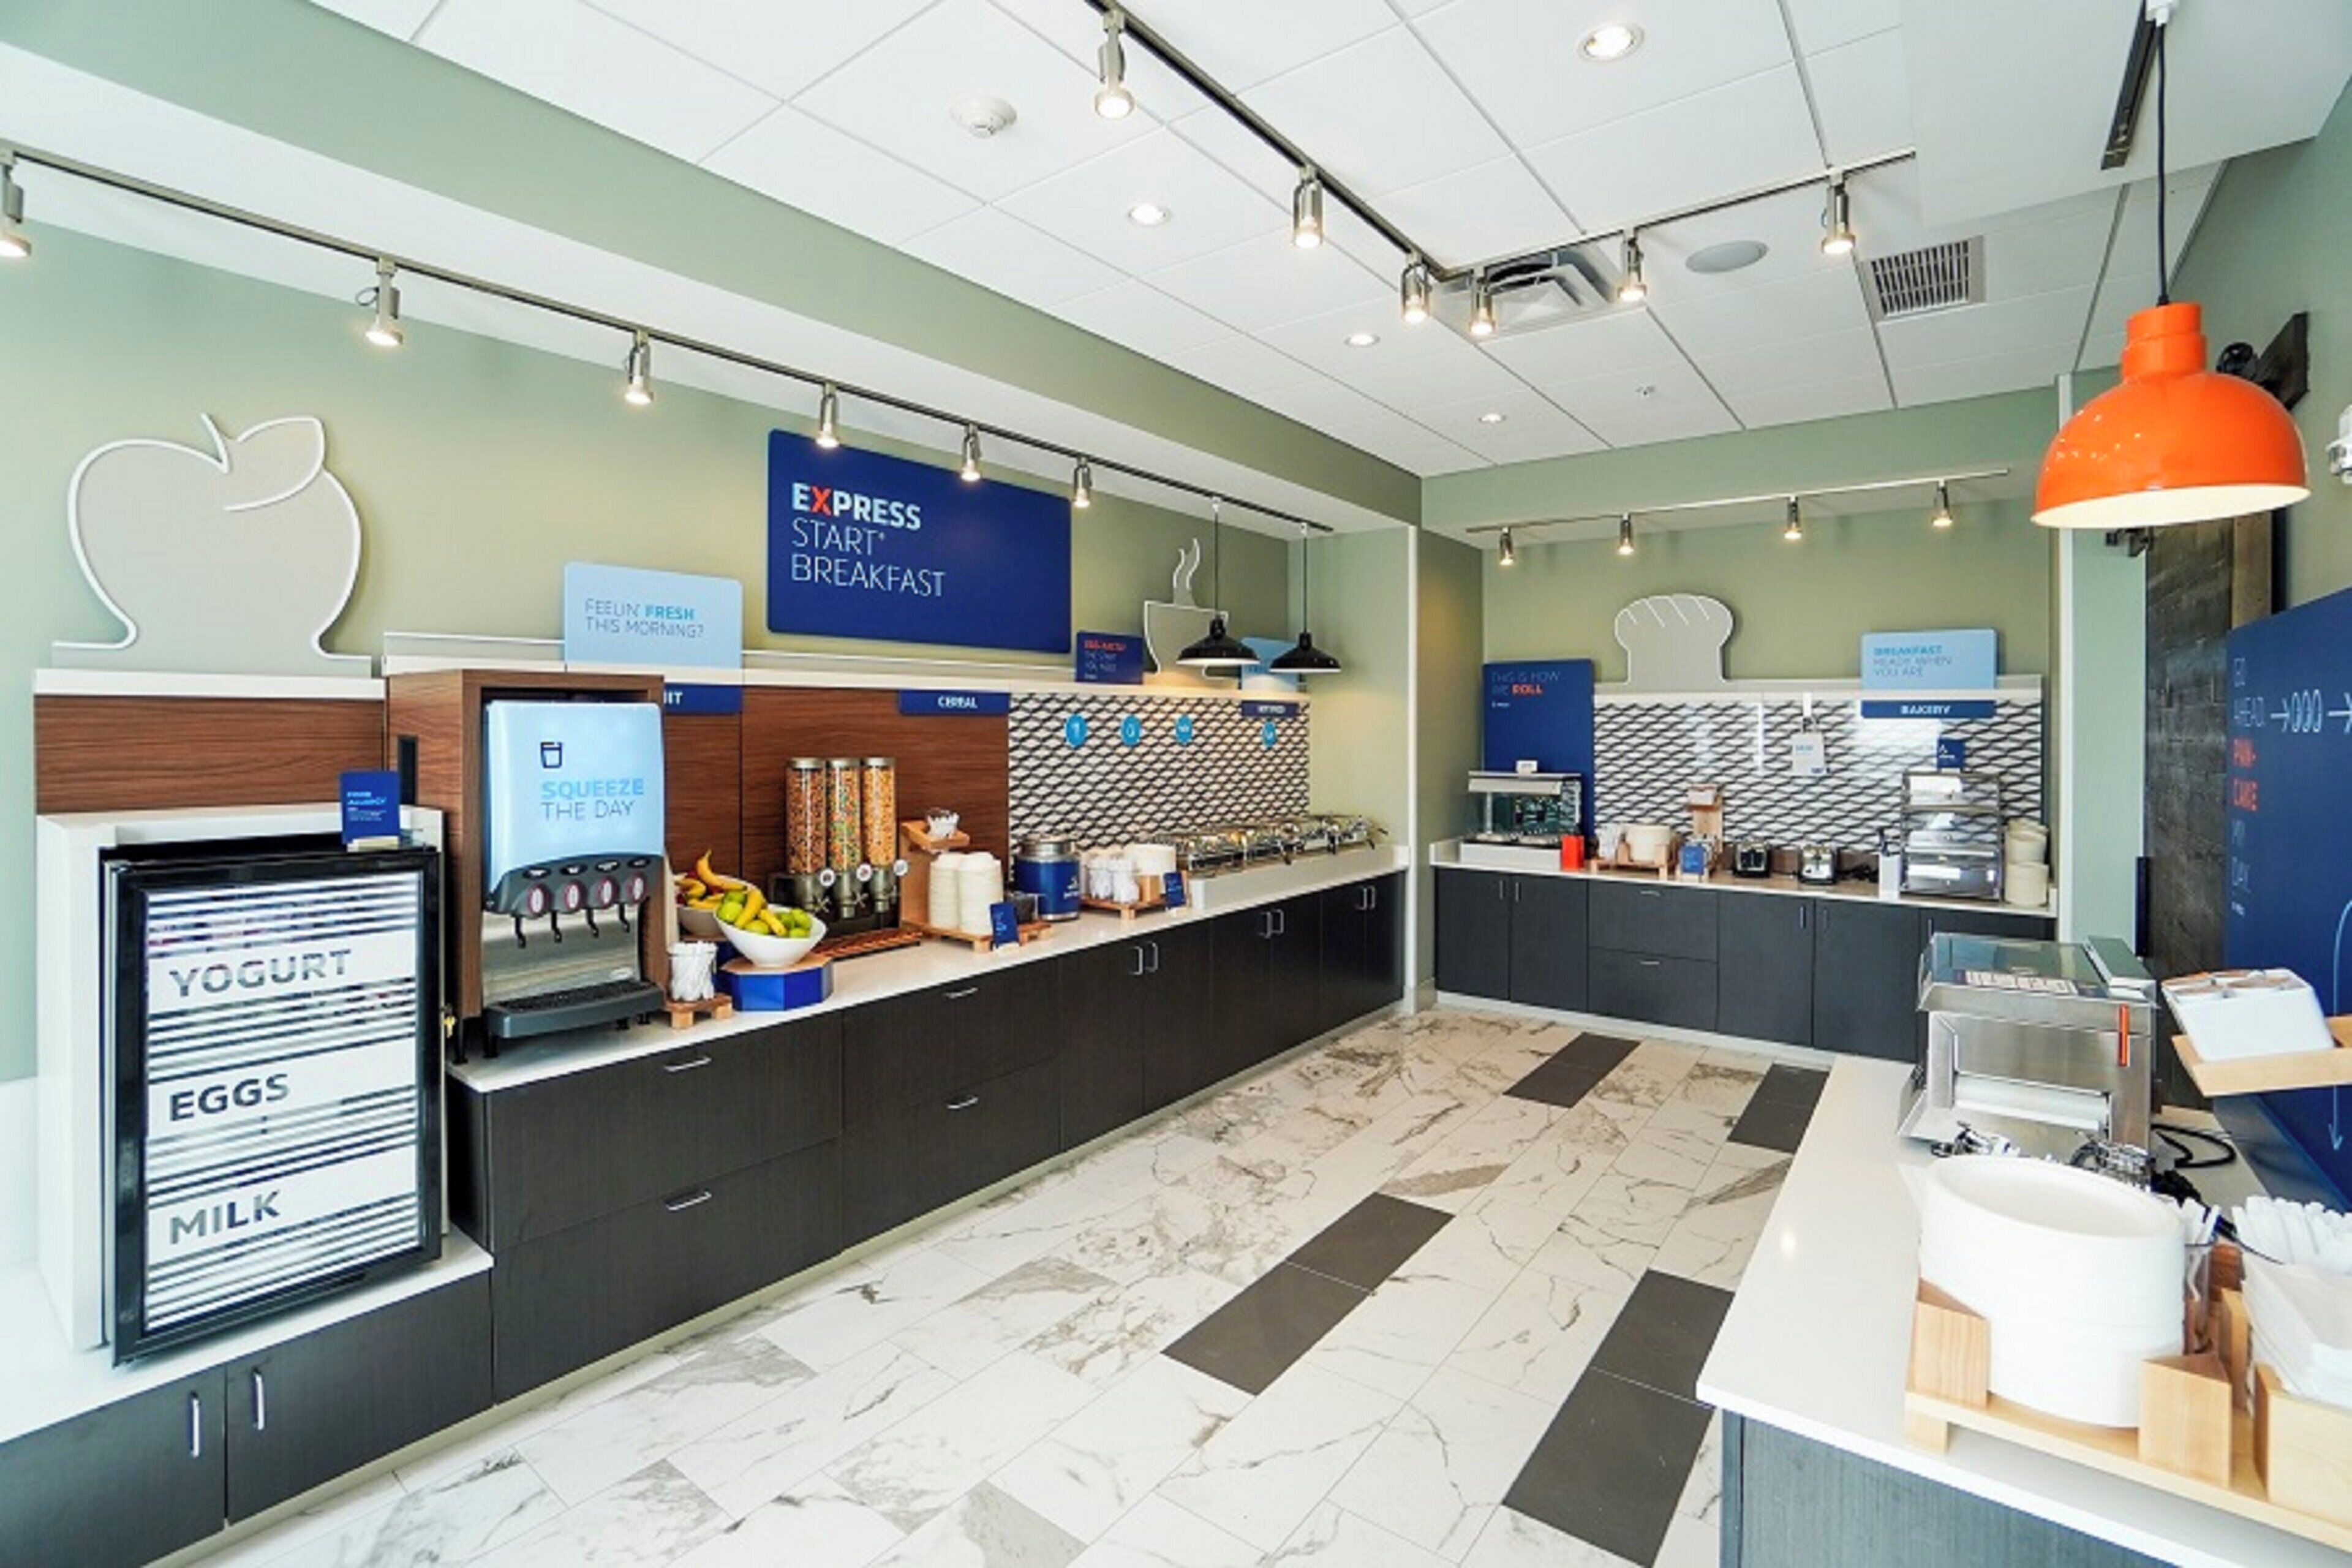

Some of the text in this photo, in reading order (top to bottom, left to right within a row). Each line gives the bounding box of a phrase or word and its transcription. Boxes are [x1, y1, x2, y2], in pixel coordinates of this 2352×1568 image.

[792, 482, 921, 531] EXPRESS
[791, 553, 946, 597] BREAKFAST
[645, 604, 695, 620] FRESH
[586, 616, 704, 639] THIS MORNING?
[1510, 684, 1544, 695] ROLL
[1900, 705, 1952, 715] BAKERY
[541, 778, 644, 800] SQUEEZE
[541, 799, 636, 821] THE DAY
[169, 949, 351, 997] YOGURT
[170, 1074, 290, 1121] EGGS
[170, 1190, 281, 1245] MILK
